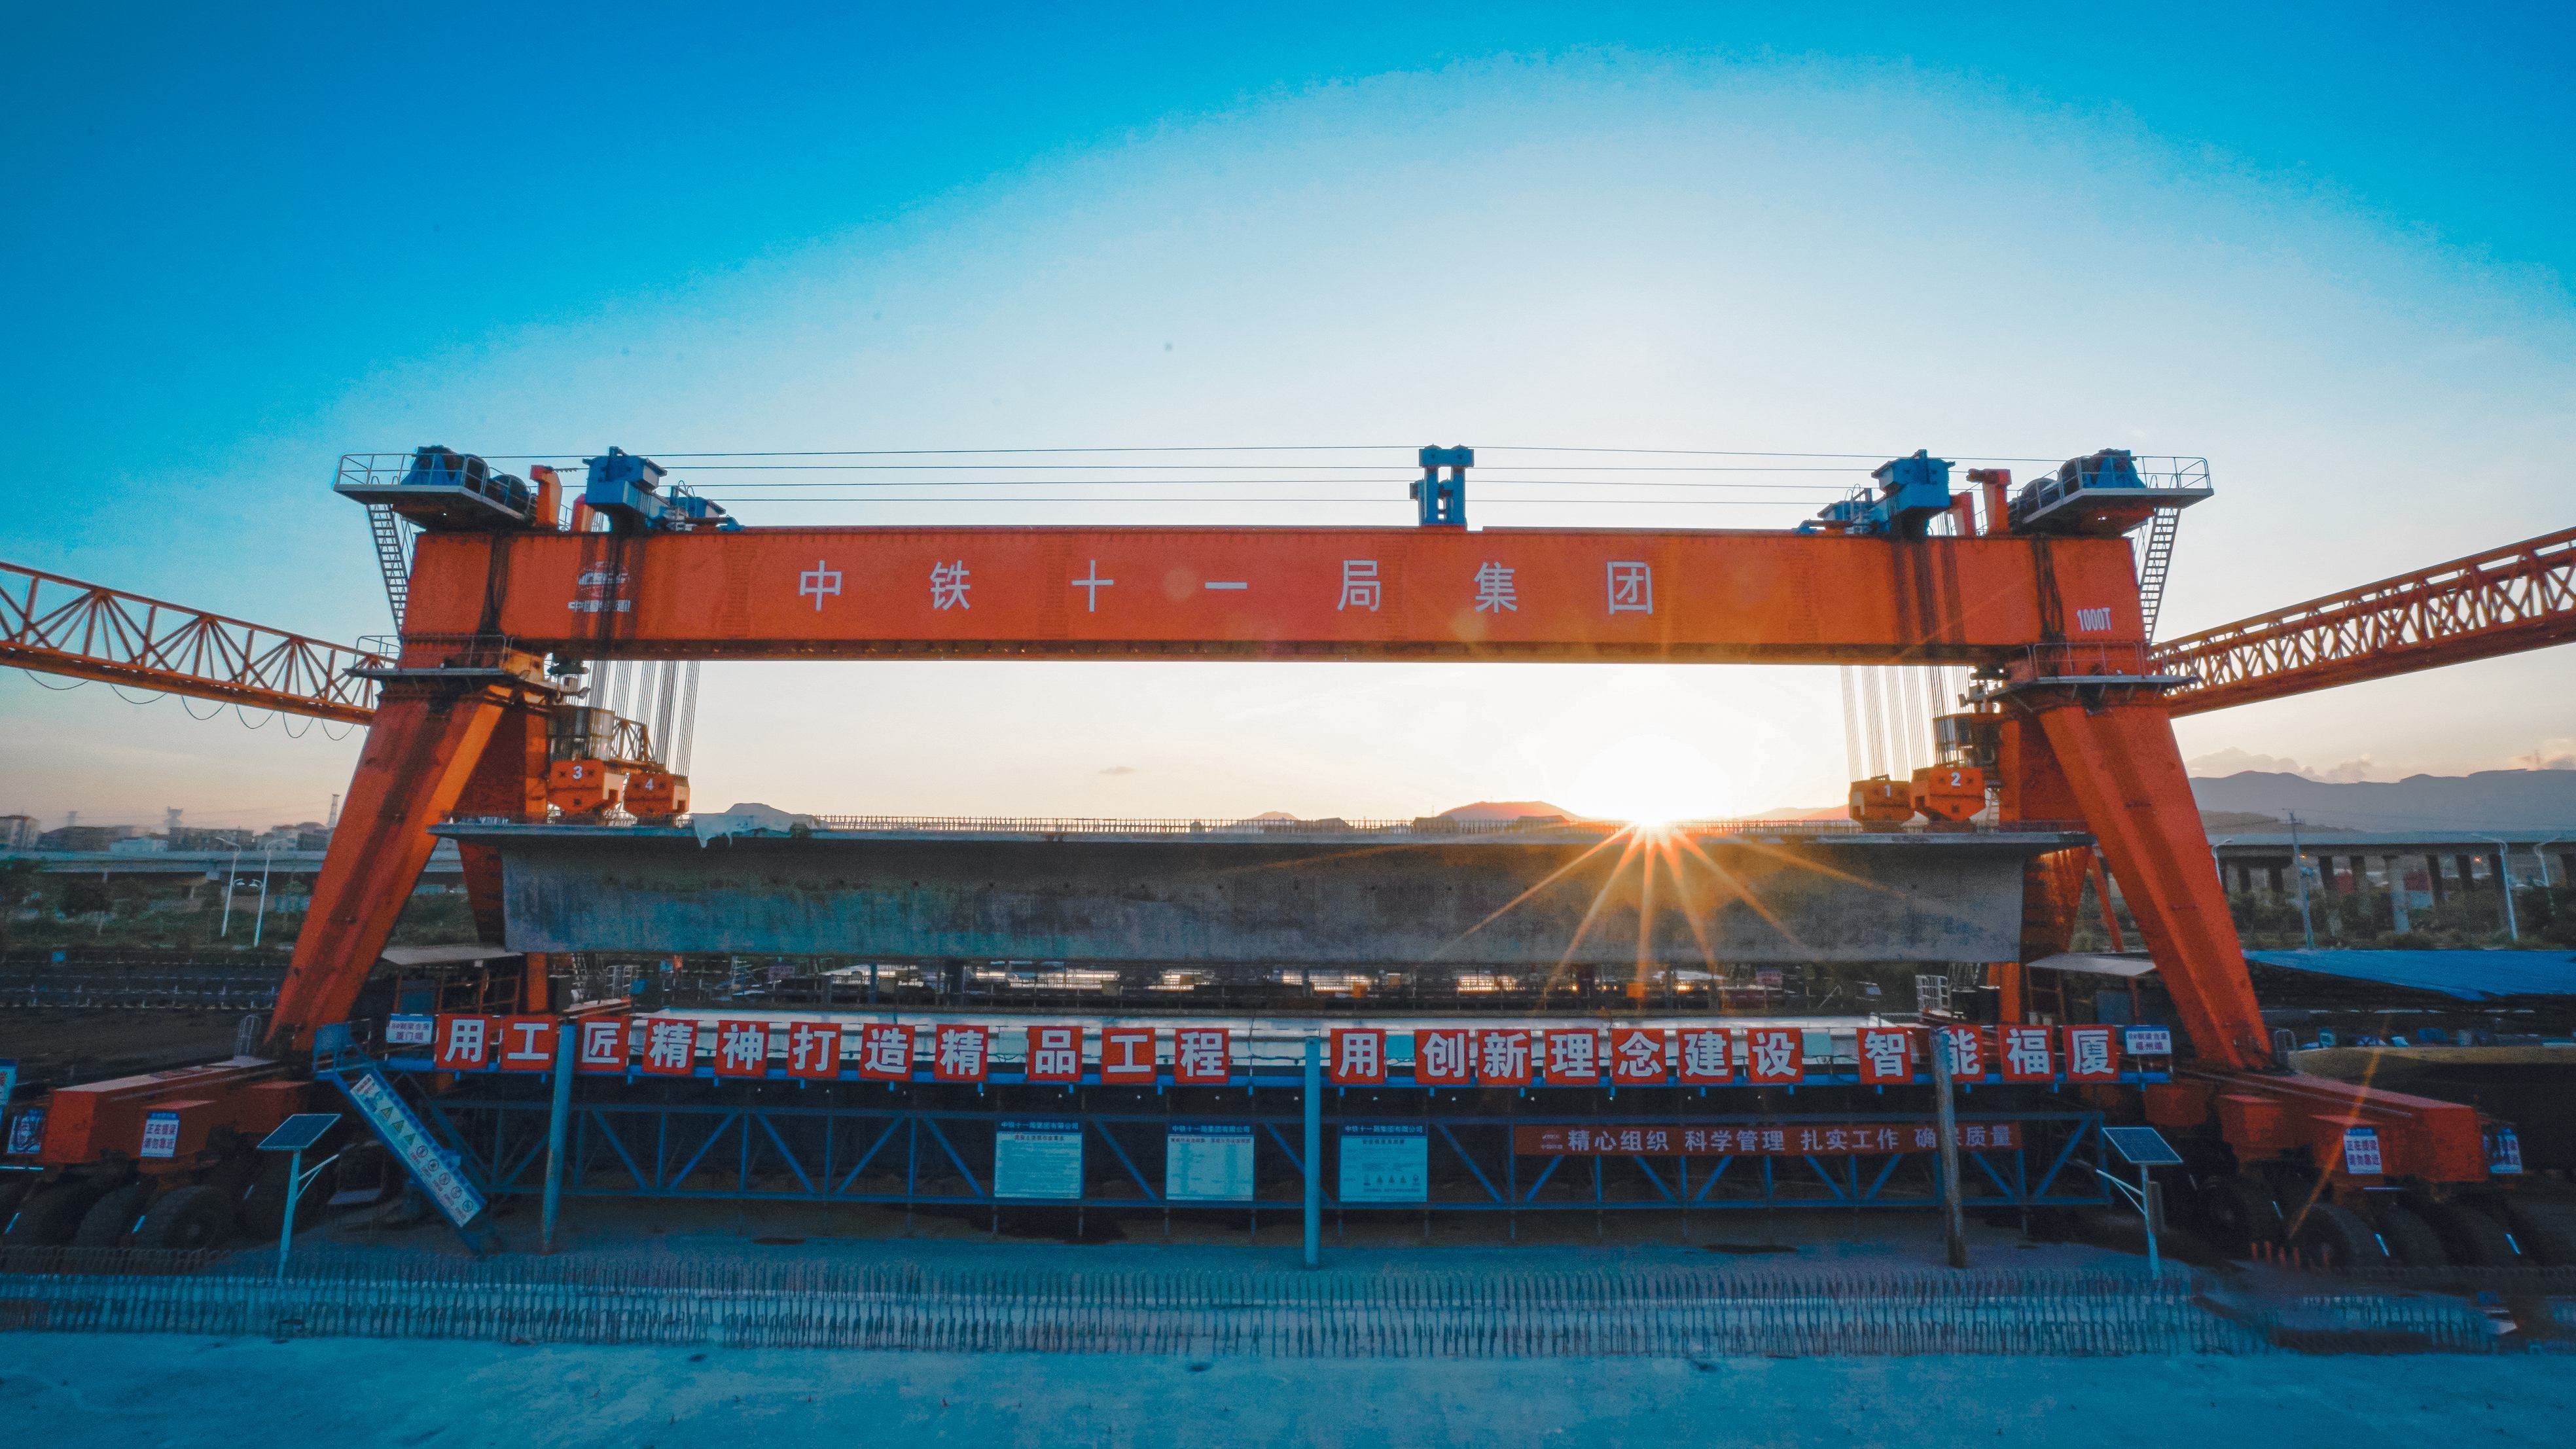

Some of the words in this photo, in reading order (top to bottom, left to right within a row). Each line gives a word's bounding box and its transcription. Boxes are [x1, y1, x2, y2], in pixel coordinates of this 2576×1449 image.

[799, 560, 1653, 615] 中铁十一局集团
[2077, 607, 2112, 631] 1000T
[572, 765, 583, 779] 3
[1951, 772, 1961, 787] 2
[645, 778, 654, 791] 4
[1884, 785, 1891, 797] 1
[444, 1019, 1226, 1077] 用工匠精神打造精品工程
[1338, 1029, 2115, 1079] 用创新理念建设智能福厦
[1567, 1130, 1669, 1152] 精心组织
[1685, 1130, 1785, 1152] 科学管理
[1800, 1128, 1899, 1151] 扎实工作
[1915, 1125, 2012, 1148] 确质量
